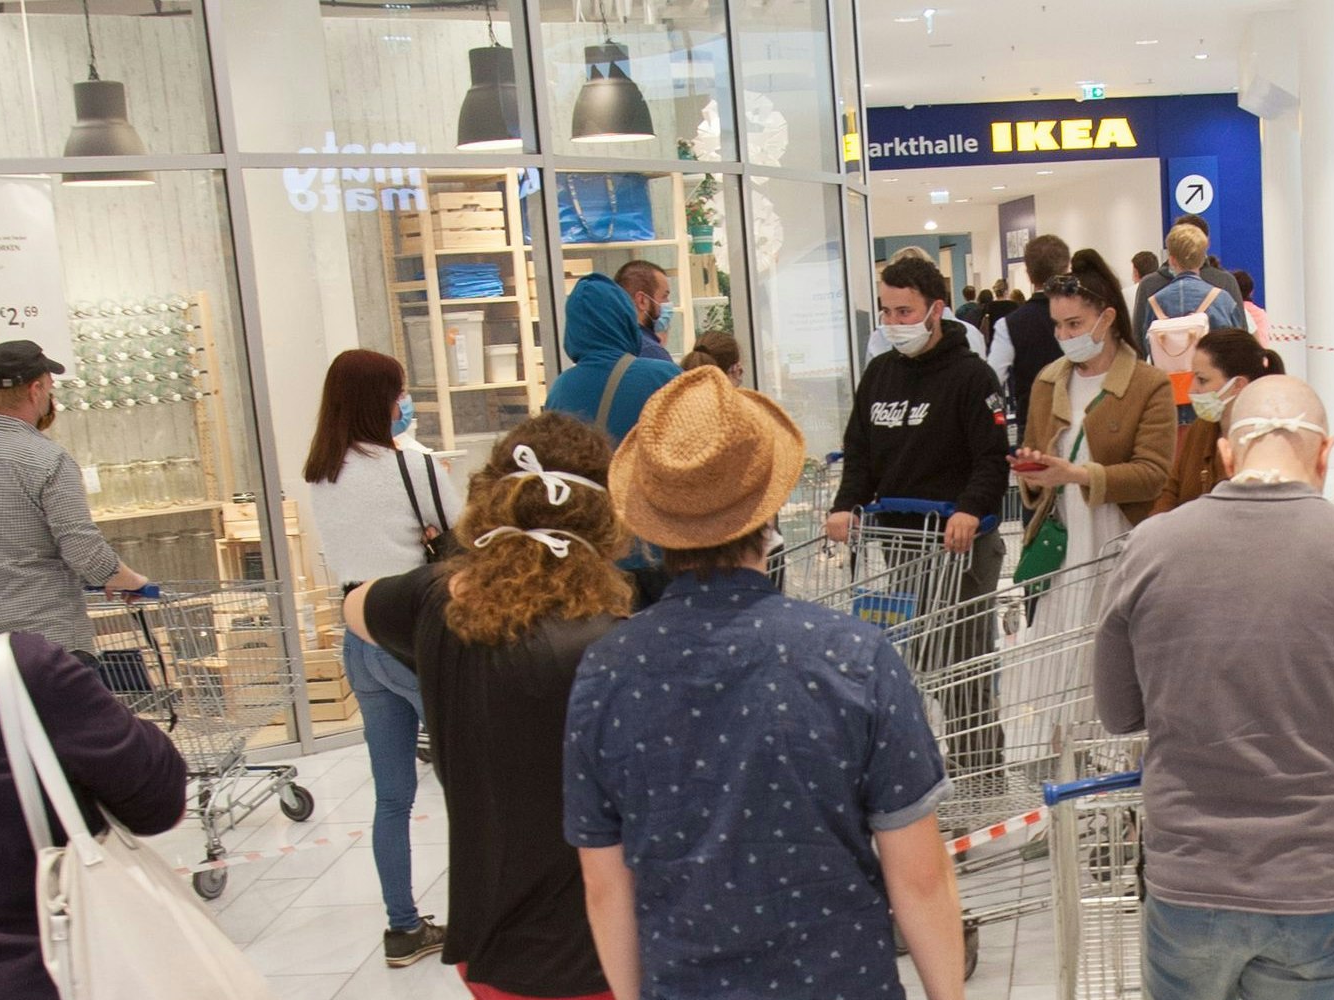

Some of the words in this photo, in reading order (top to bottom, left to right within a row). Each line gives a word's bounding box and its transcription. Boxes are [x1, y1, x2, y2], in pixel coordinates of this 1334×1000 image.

[869, 134, 979, 159] arkthalle
[990, 117, 1138, 153] IKEA
[0, 306, 39, 328] €2,69
